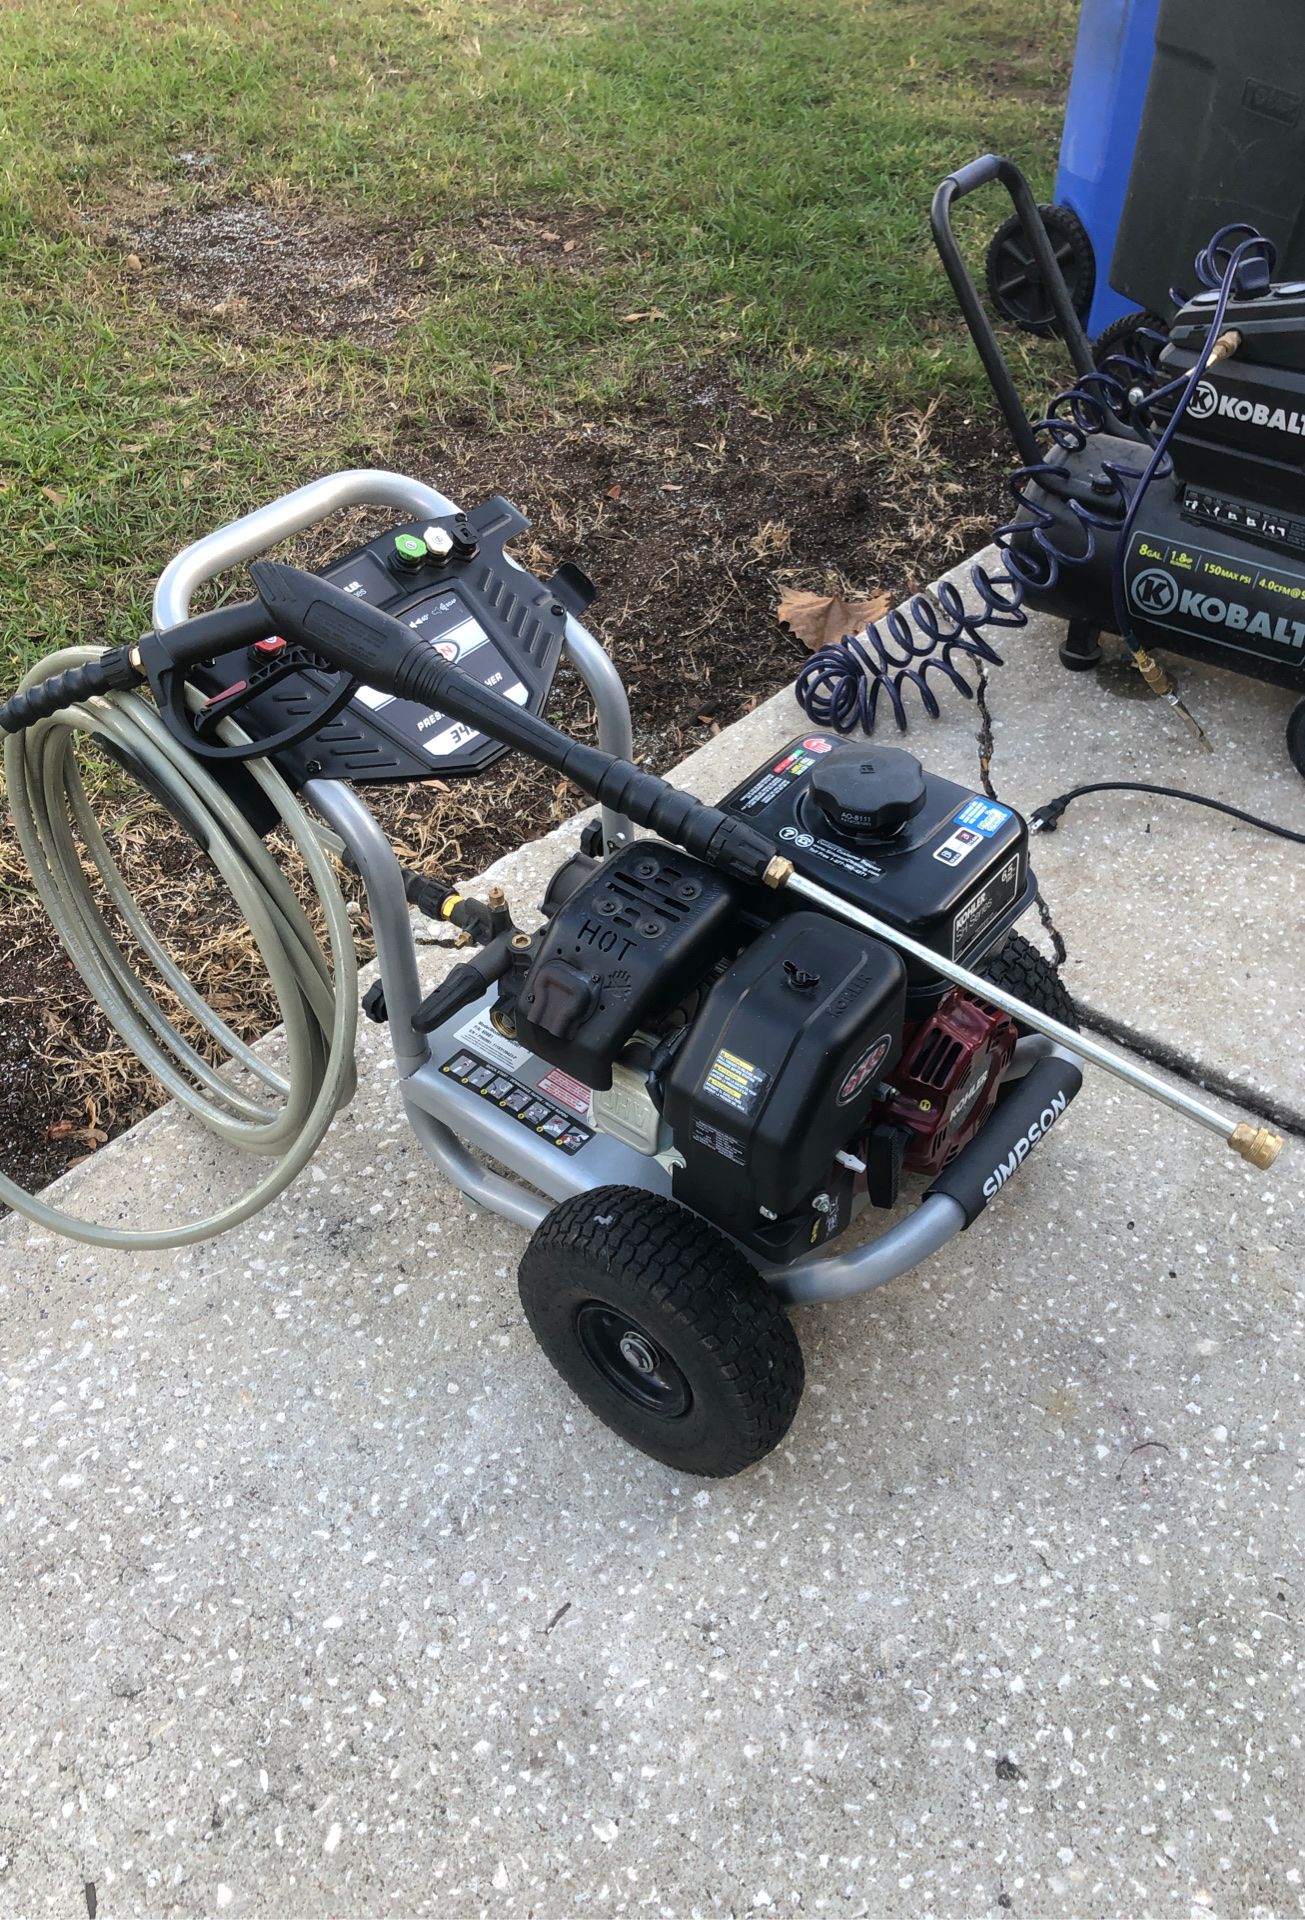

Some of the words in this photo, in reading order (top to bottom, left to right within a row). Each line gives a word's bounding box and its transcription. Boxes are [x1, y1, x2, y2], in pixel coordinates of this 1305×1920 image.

[1179, 589, 1305, 648] KOBALT
[956, 892, 986, 928] KOHLER
[577, 919, 638, 961] HOT
[949, 1069, 989, 1122] KOHLER
[982, 1090, 1066, 1204] SIMPSON
